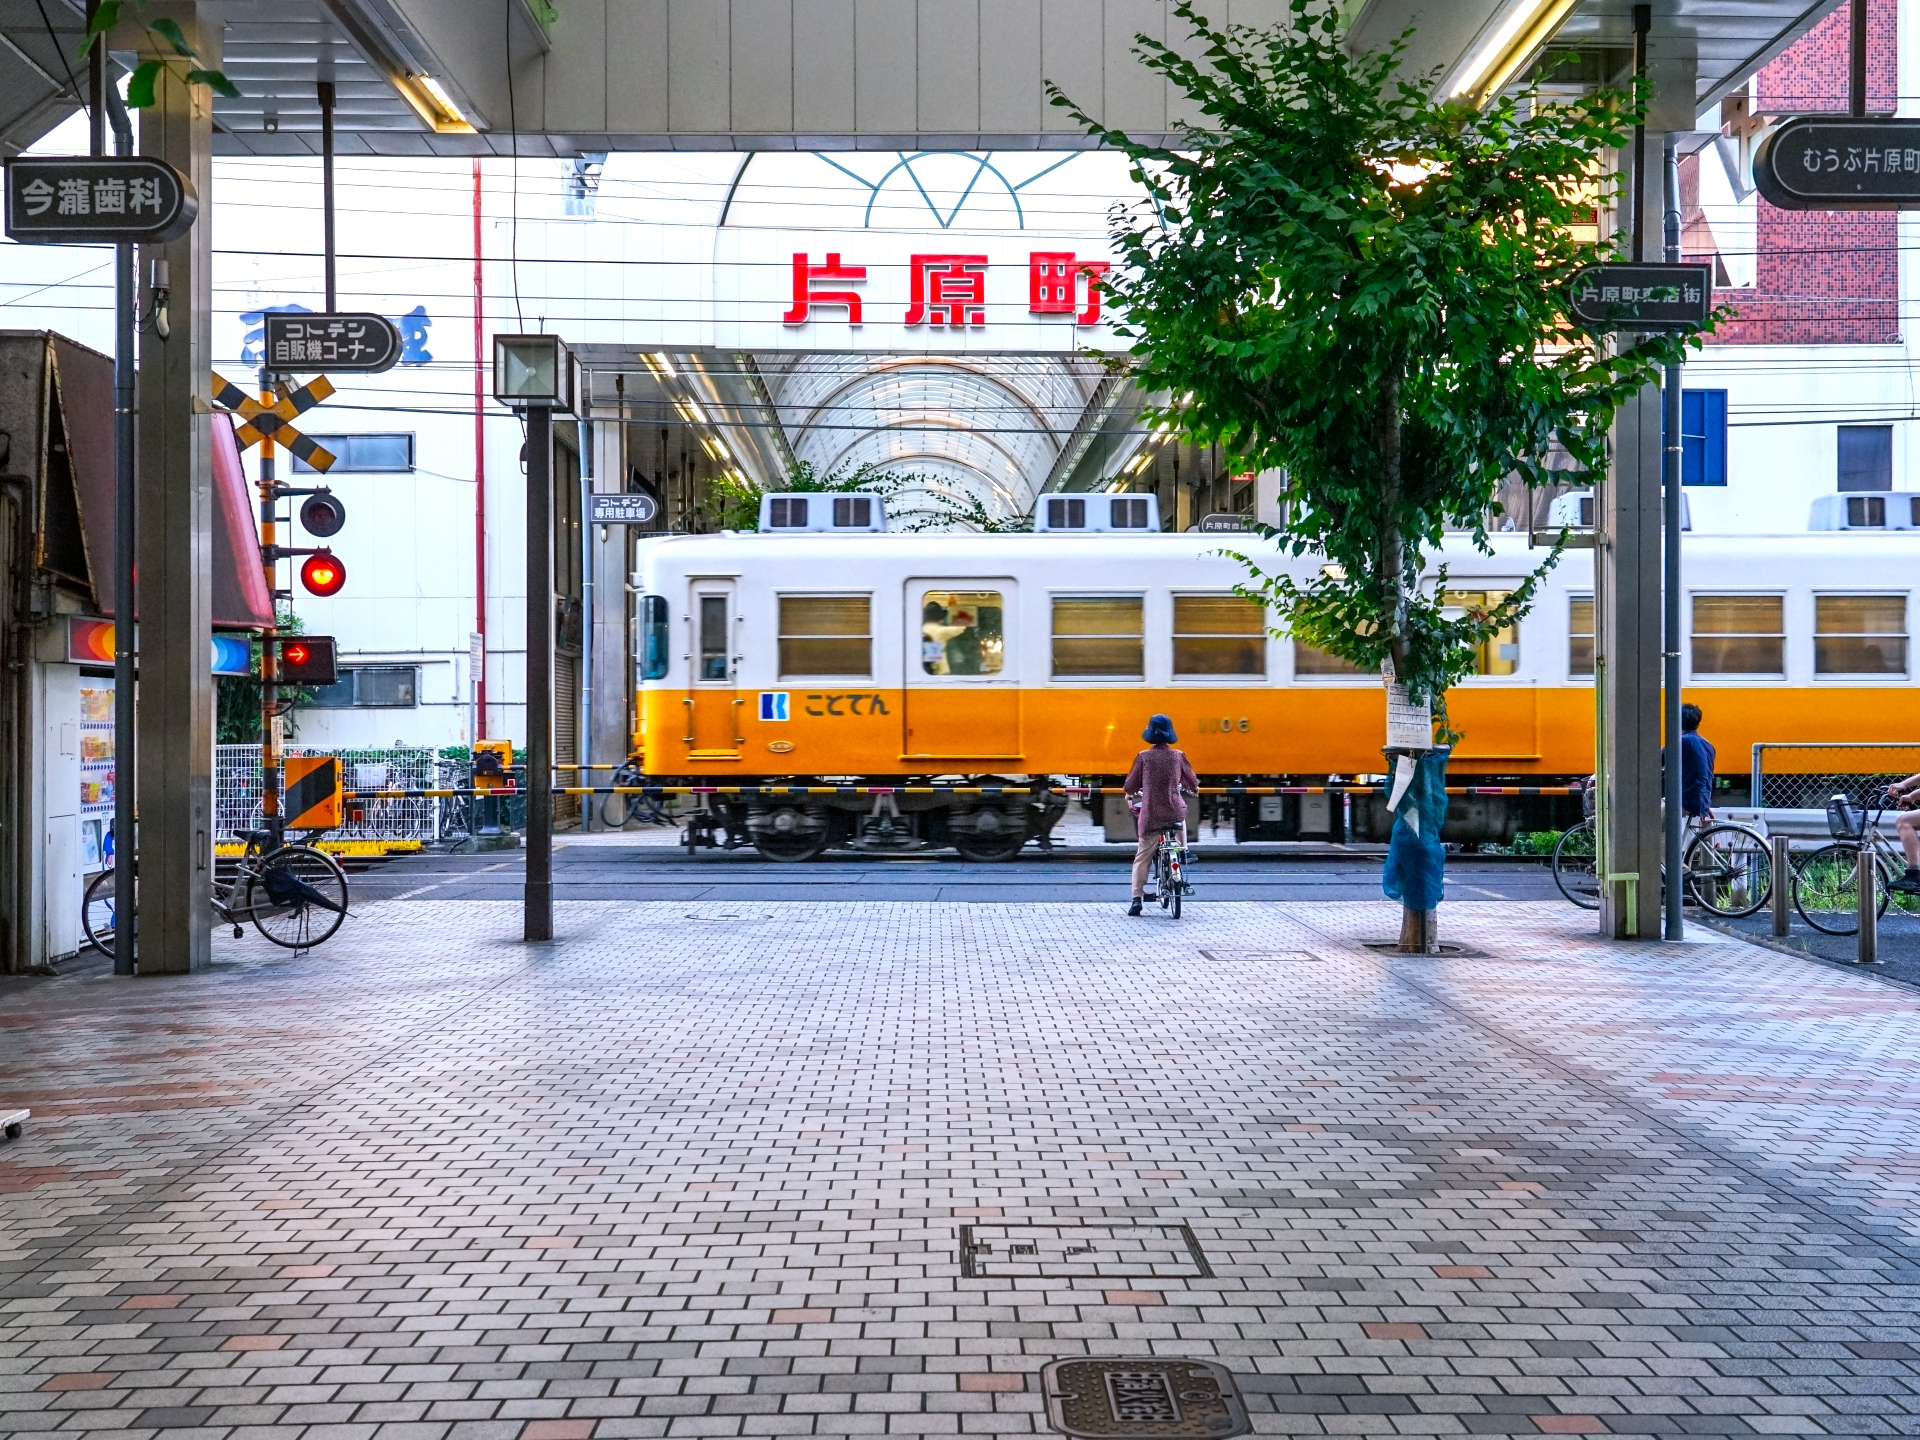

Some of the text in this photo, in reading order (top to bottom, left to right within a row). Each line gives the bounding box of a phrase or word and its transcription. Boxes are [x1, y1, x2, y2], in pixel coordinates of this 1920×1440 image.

[1803, 147, 1920, 173] むうぶ片原町
[21, 177, 163, 216] 今瀧歯科
[783, 252, 1111, 327] 片原町
[285, 320, 366, 338] コトデン
[275, 340, 376, 361] 自販機コーナー
[594, 507, 646, 519] 専用駐車場
[599, 498, 642, 507] コトデン
